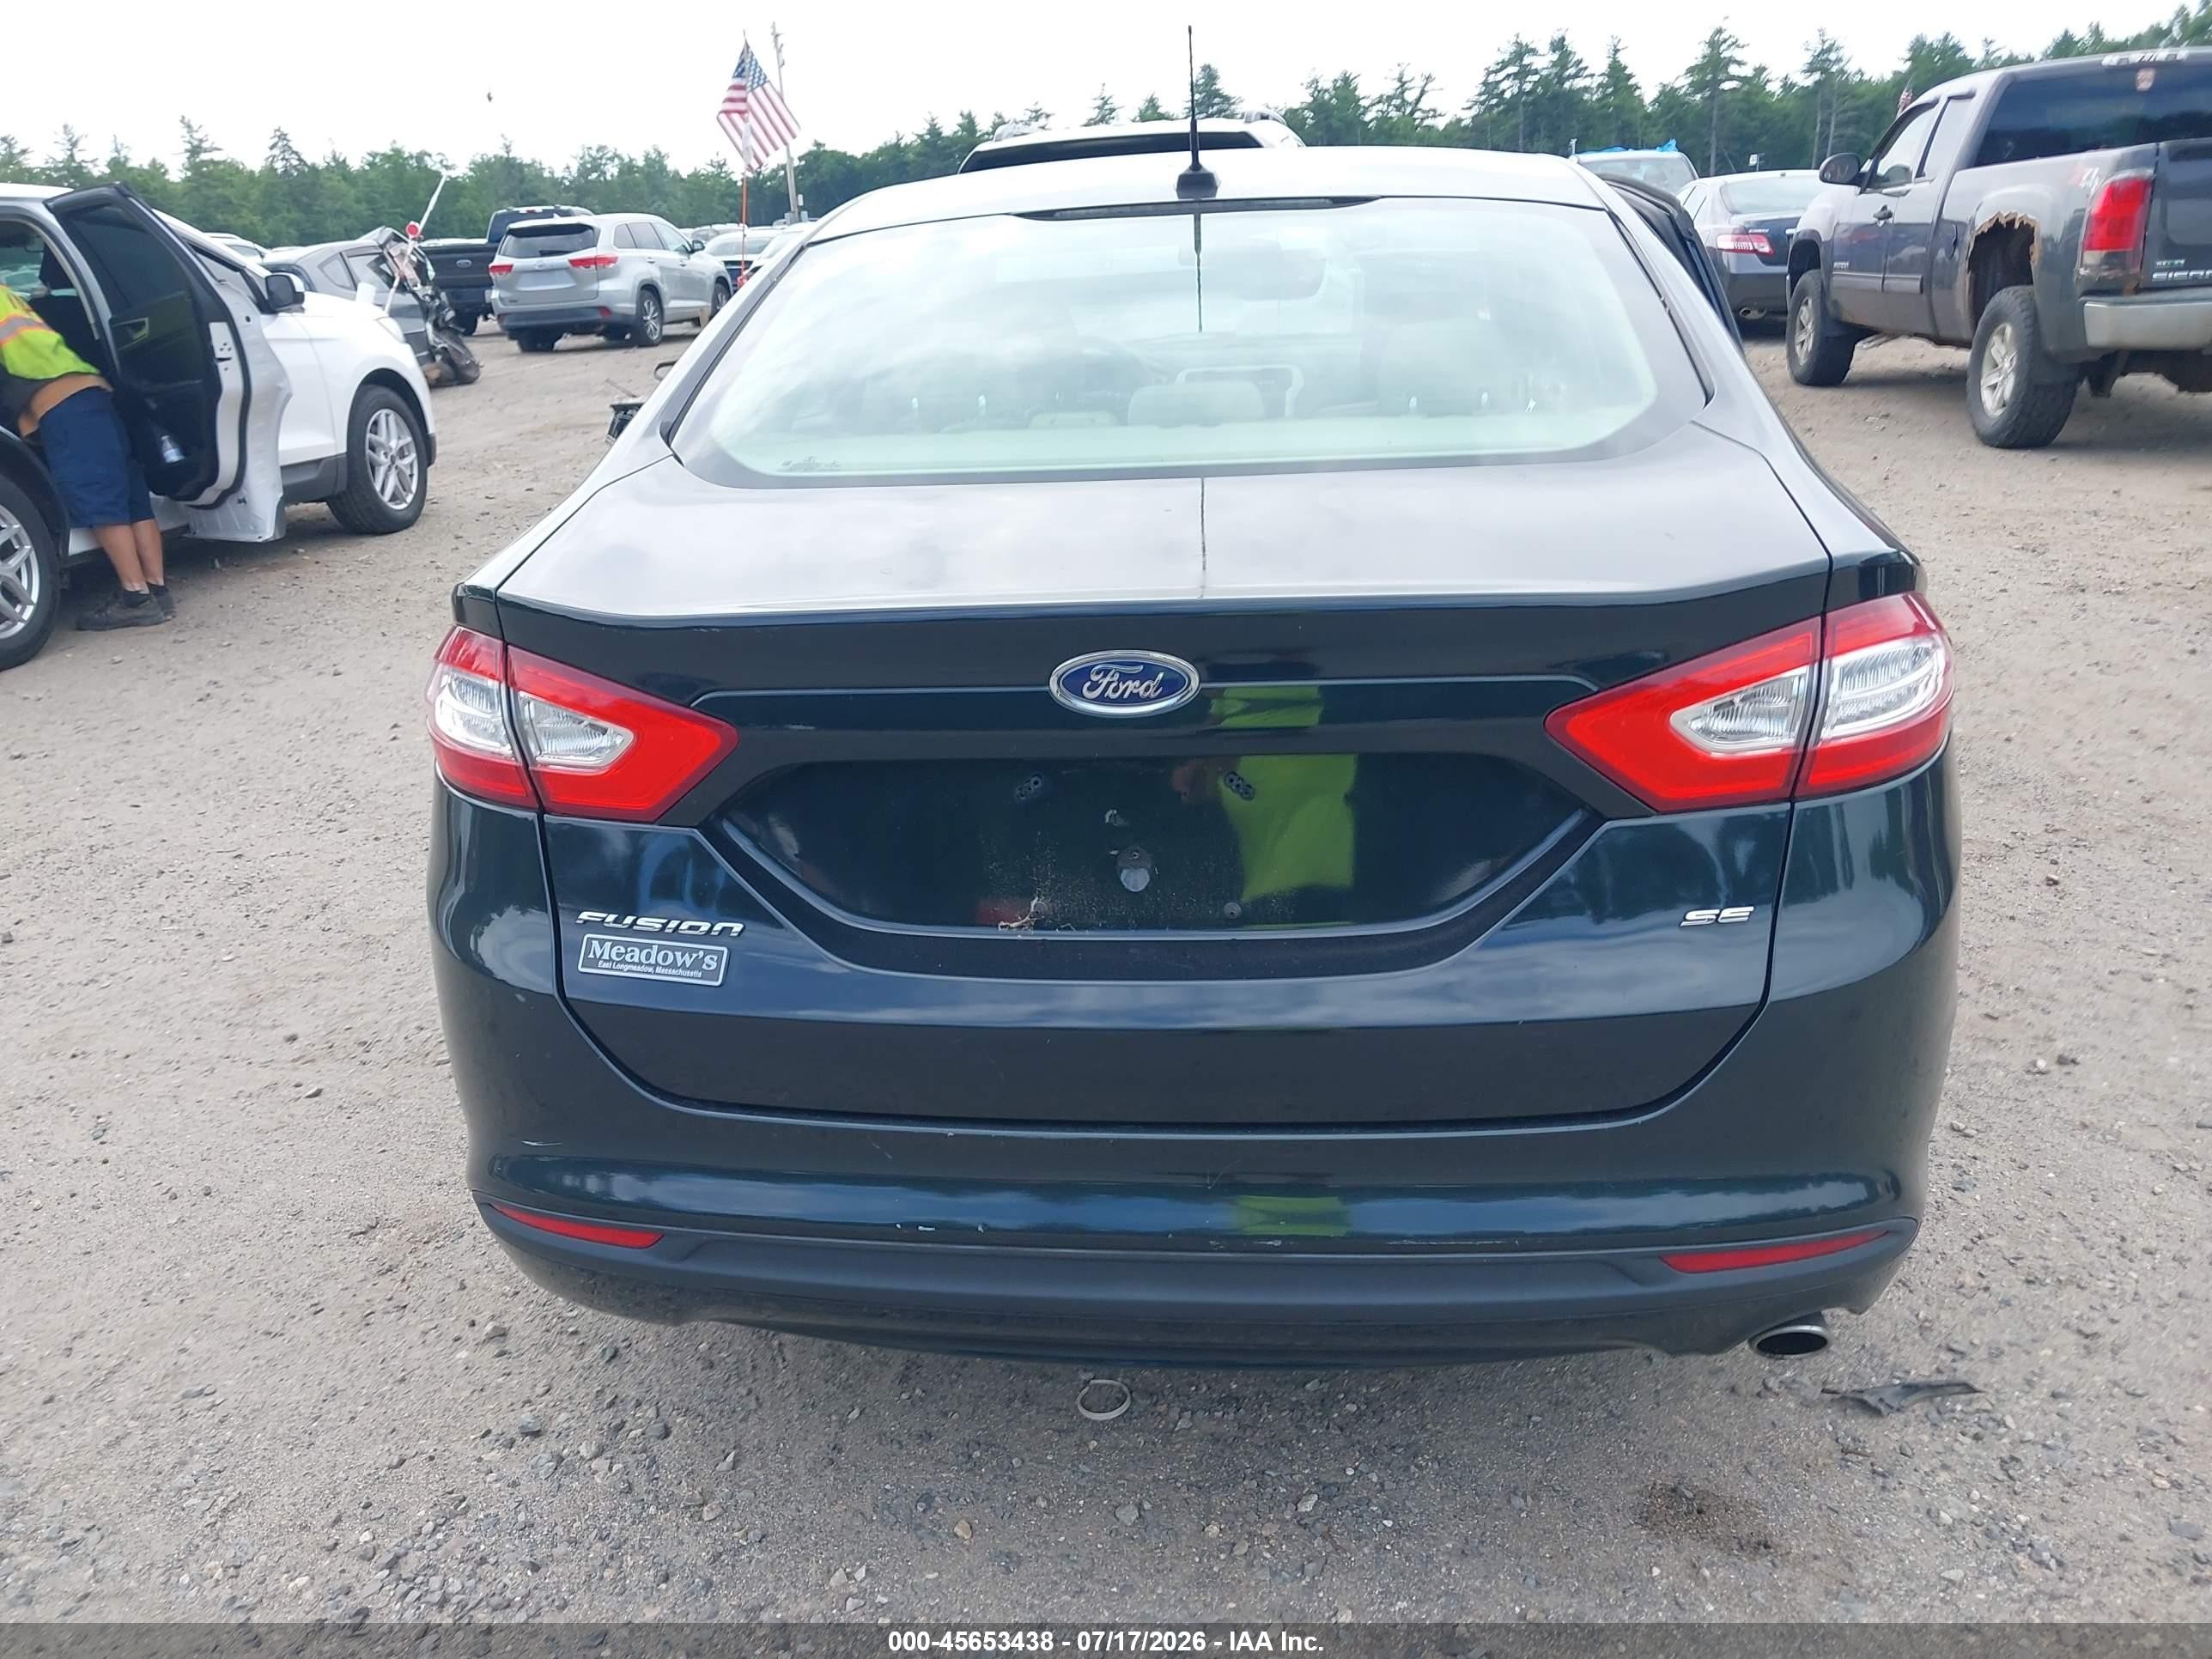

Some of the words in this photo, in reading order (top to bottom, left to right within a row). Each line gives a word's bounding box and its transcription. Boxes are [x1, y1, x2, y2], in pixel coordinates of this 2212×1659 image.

[1082, 664, 1164, 699] Ford
[575, 910, 745, 937] FUSION
[1680, 906, 1754, 927] SE
[587, 940, 718, 971] Meadow's
[598, 960, 612, 969] East
